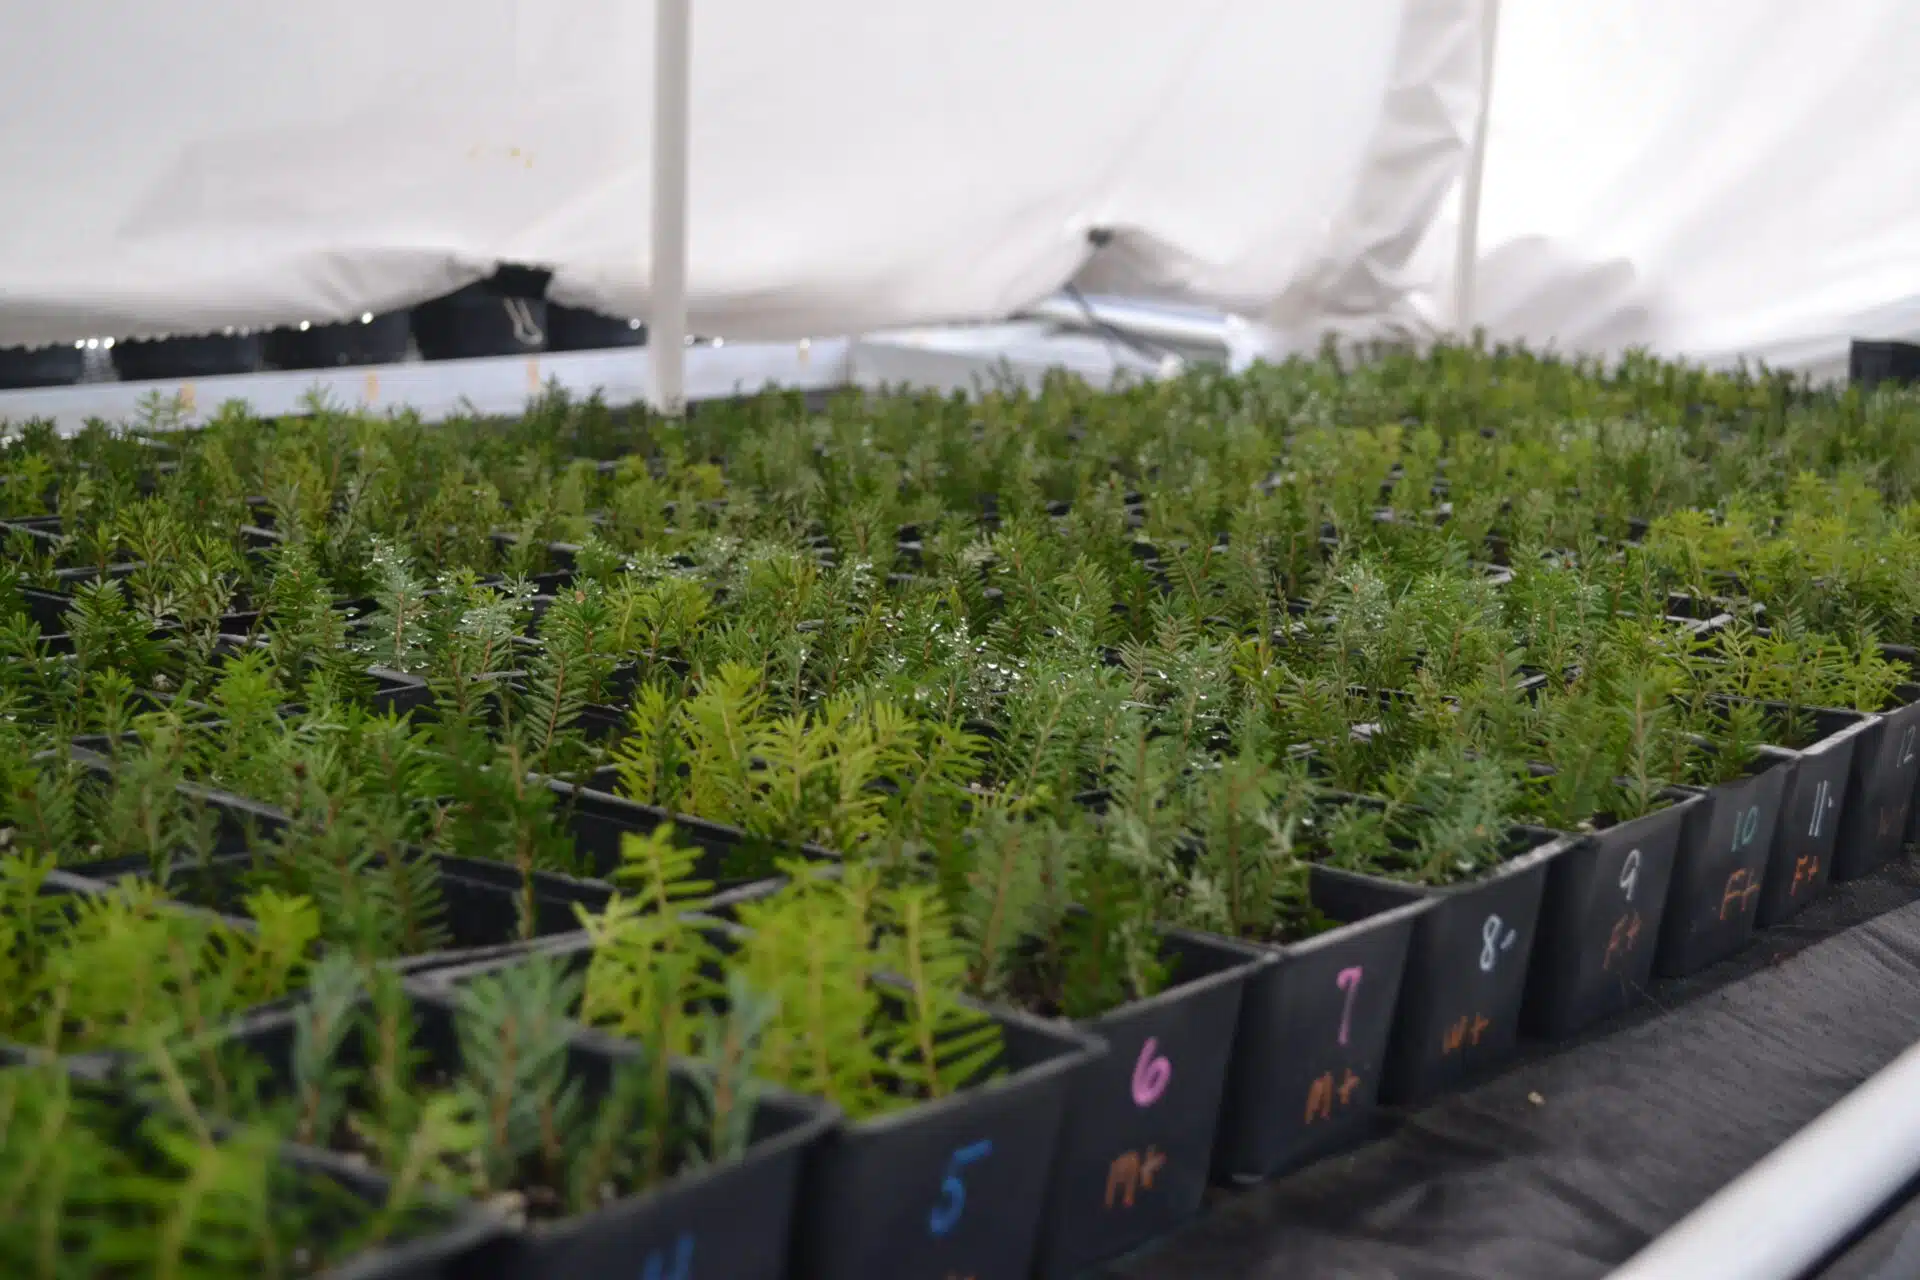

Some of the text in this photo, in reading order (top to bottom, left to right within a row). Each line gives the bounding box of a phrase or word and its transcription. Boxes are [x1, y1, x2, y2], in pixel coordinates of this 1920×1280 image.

[1731, 805, 1760, 853] 10
[1618, 848, 1641, 901] 9
[1336, 965, 1363, 1046] 7
[1131, 1036, 1171, 1107] 6
[929, 1139, 992, 1235] 5
